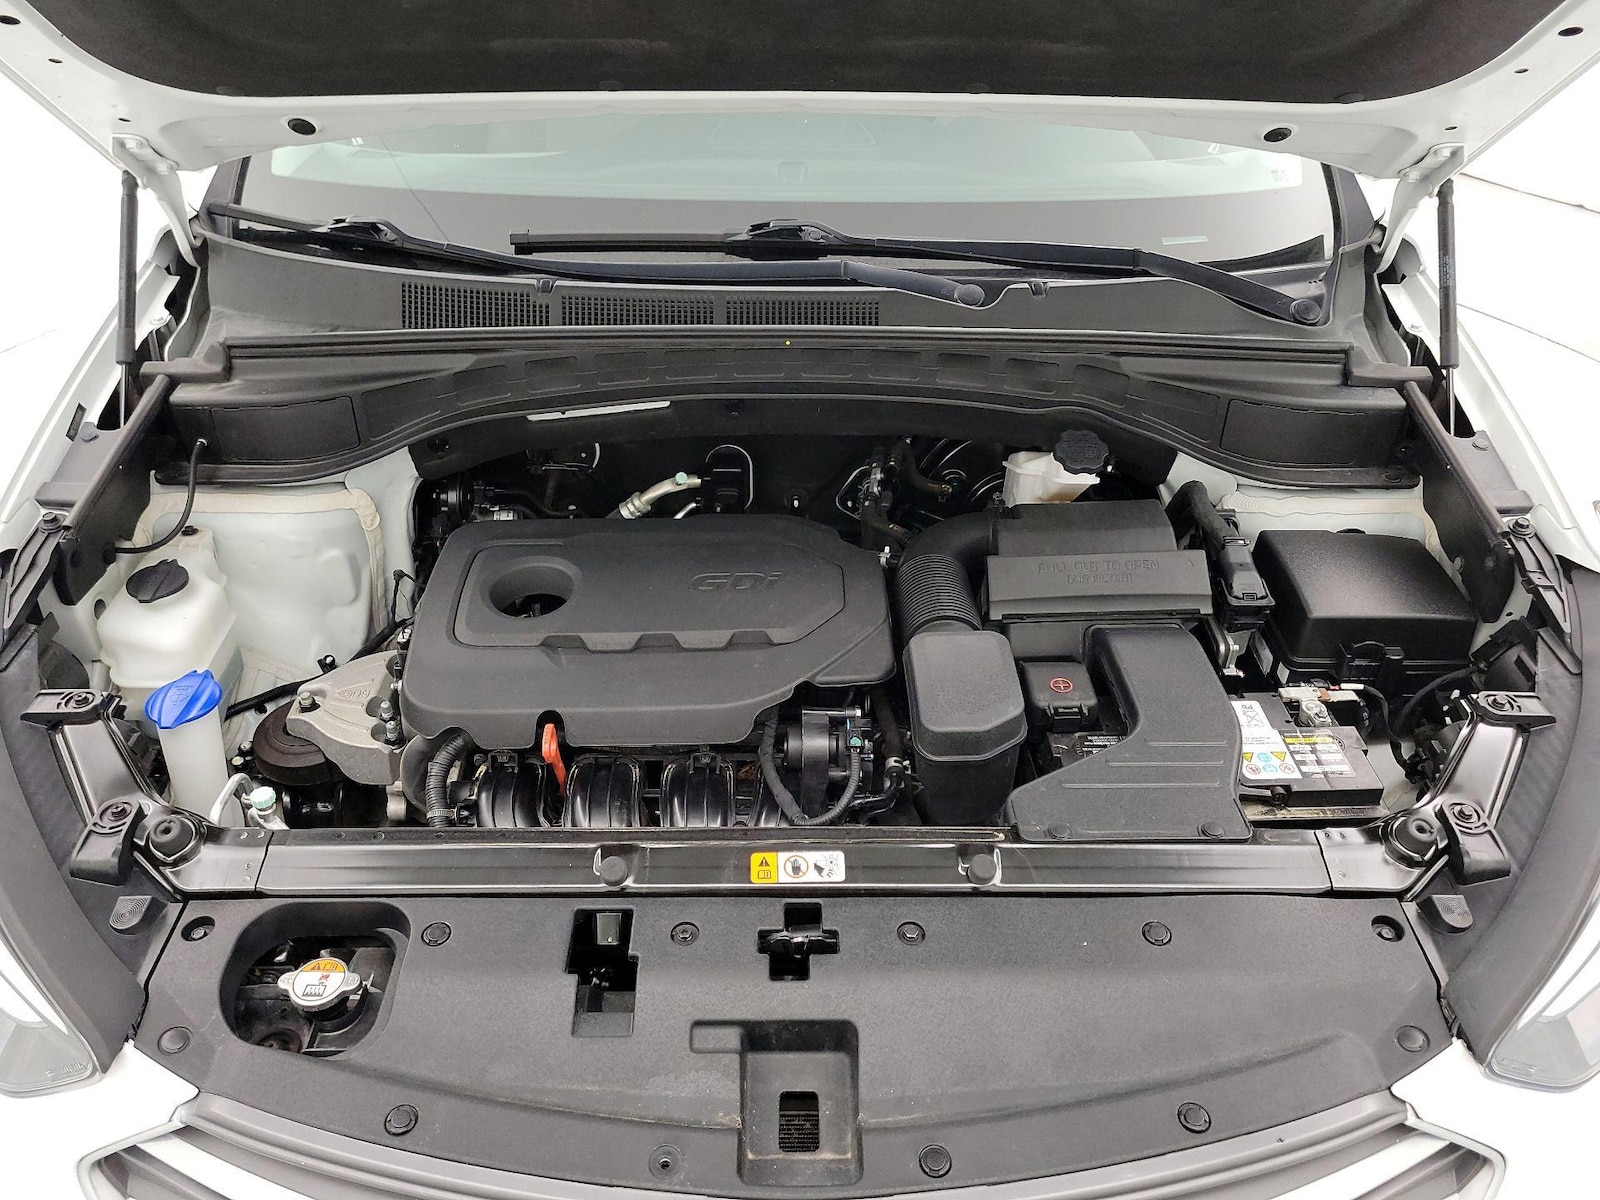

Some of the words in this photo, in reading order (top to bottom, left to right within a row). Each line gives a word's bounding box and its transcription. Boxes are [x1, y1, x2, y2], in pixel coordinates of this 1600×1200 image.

[1037, 561, 1066, 573] PULL
[1074, 560, 1098, 572] OUT
[1103, 559, 1120, 571] TO
[1124, 558, 1160, 570] OPEN
